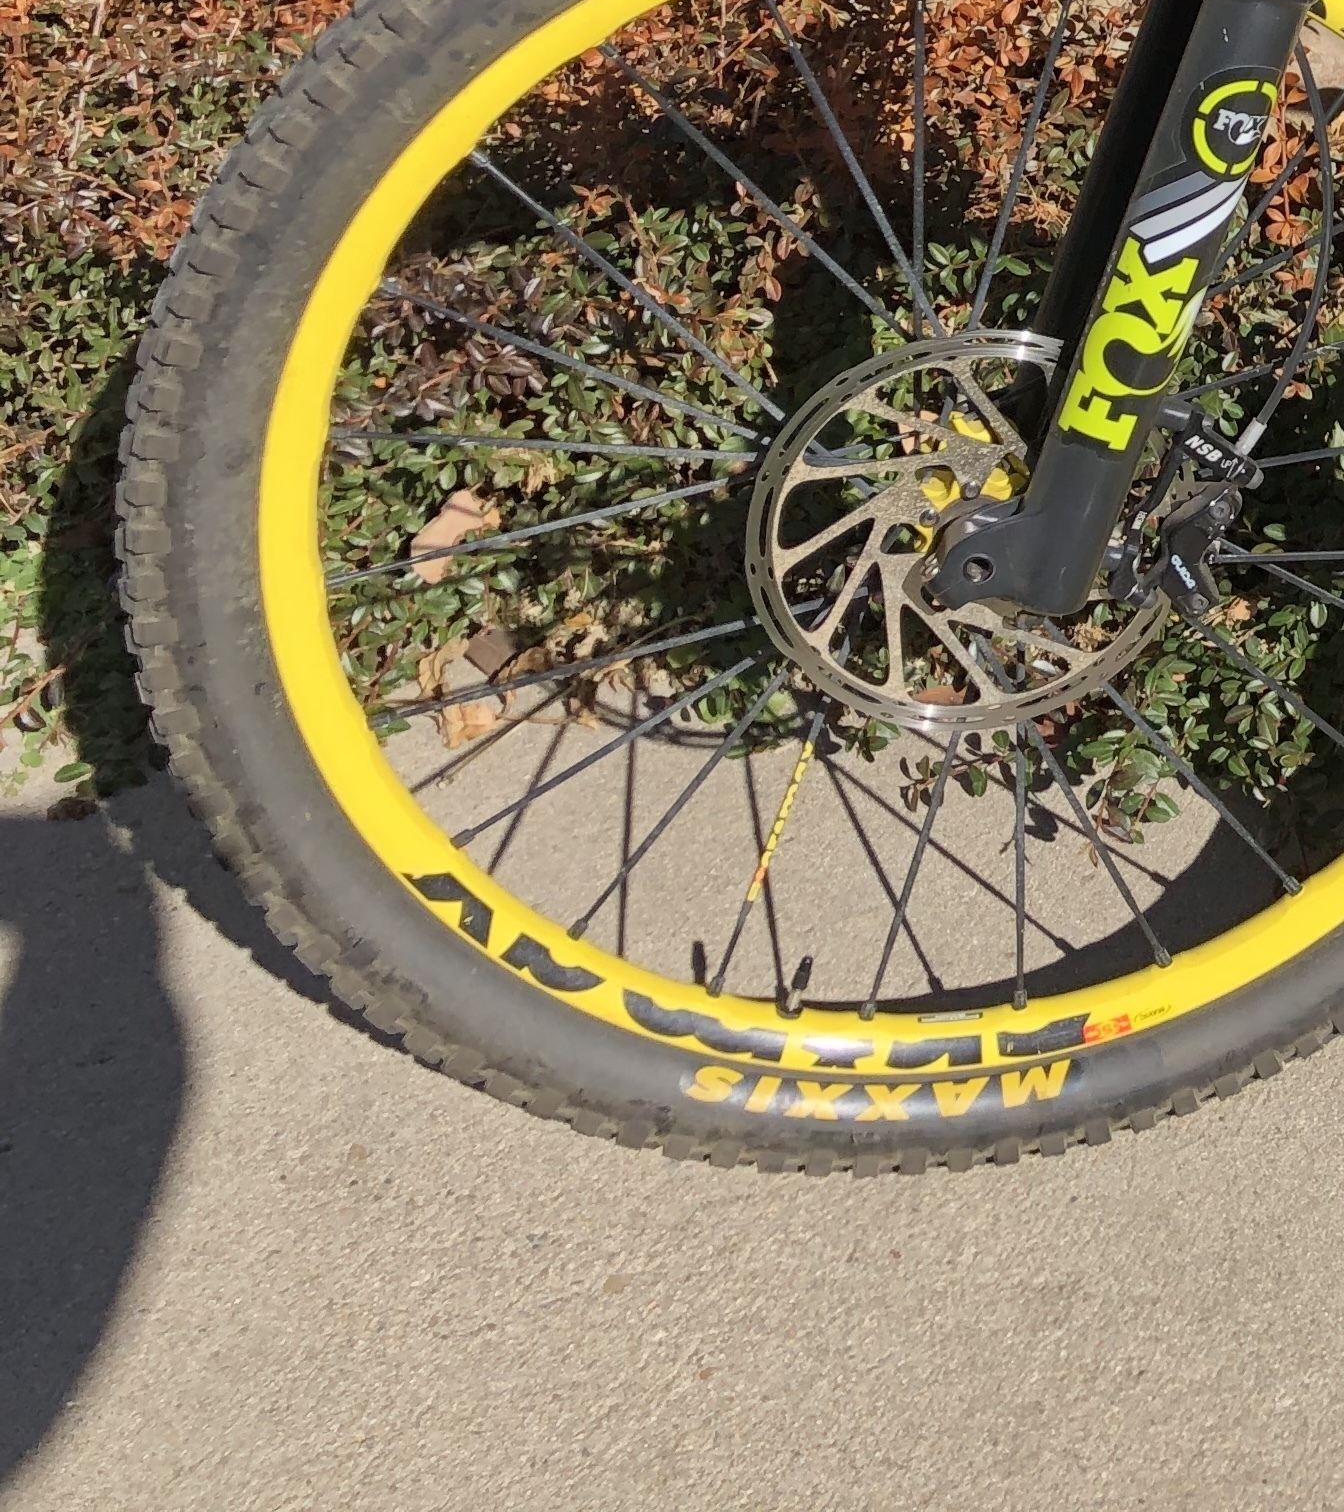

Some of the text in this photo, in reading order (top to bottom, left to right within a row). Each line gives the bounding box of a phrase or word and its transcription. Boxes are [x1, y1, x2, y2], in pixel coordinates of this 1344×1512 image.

[1212, 108, 1268, 145] FOX
[1058, 237, 1208, 451] FOX
[1185, 434, 1223, 463] NSB
[685, 1058, 1071, 1122] MAXXIS
